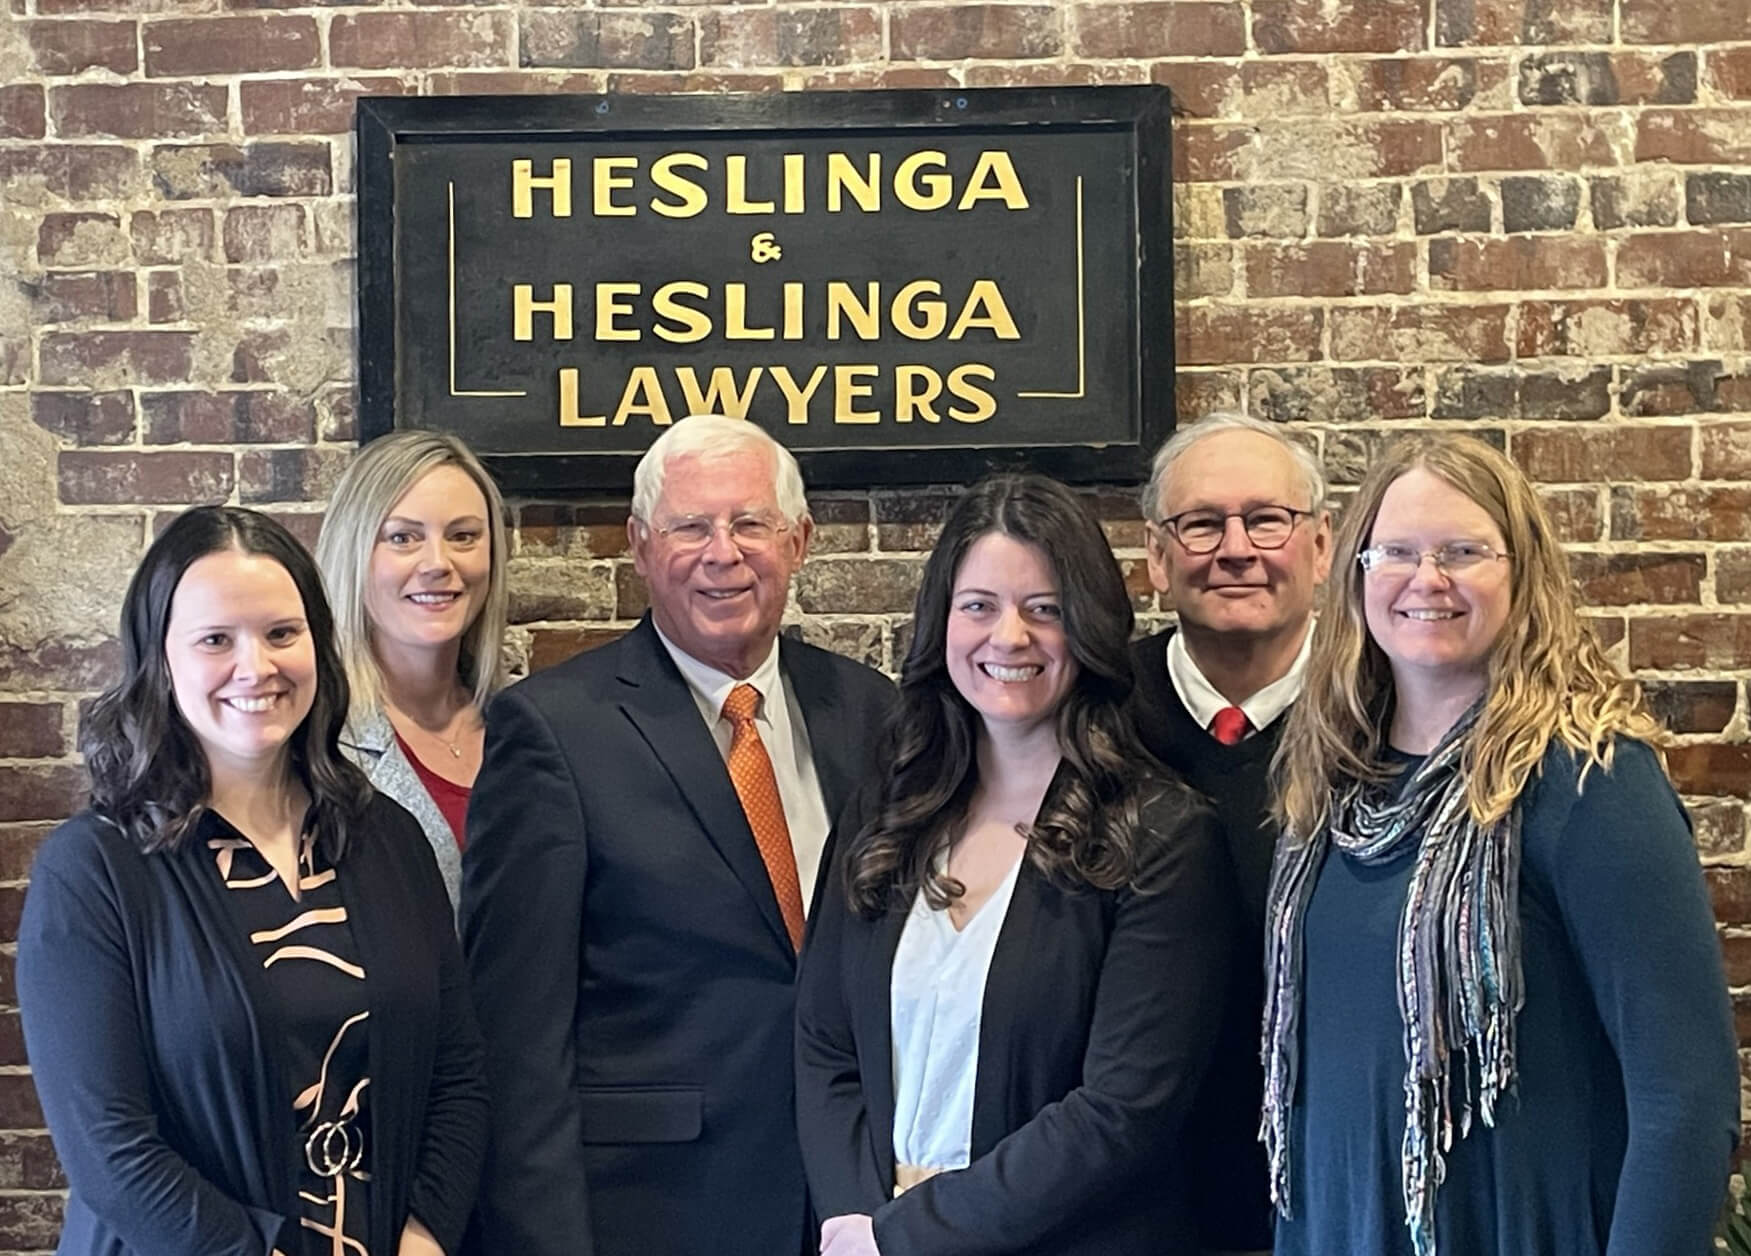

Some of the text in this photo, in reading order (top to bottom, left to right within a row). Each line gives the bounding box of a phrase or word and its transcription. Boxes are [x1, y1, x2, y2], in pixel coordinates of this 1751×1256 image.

[512, 150, 1029, 219] HESLINGA
[750, 231, 783, 264] &
[513, 279, 1021, 344] HESLINGA
[558, 363, 997, 427] LAWYERS
